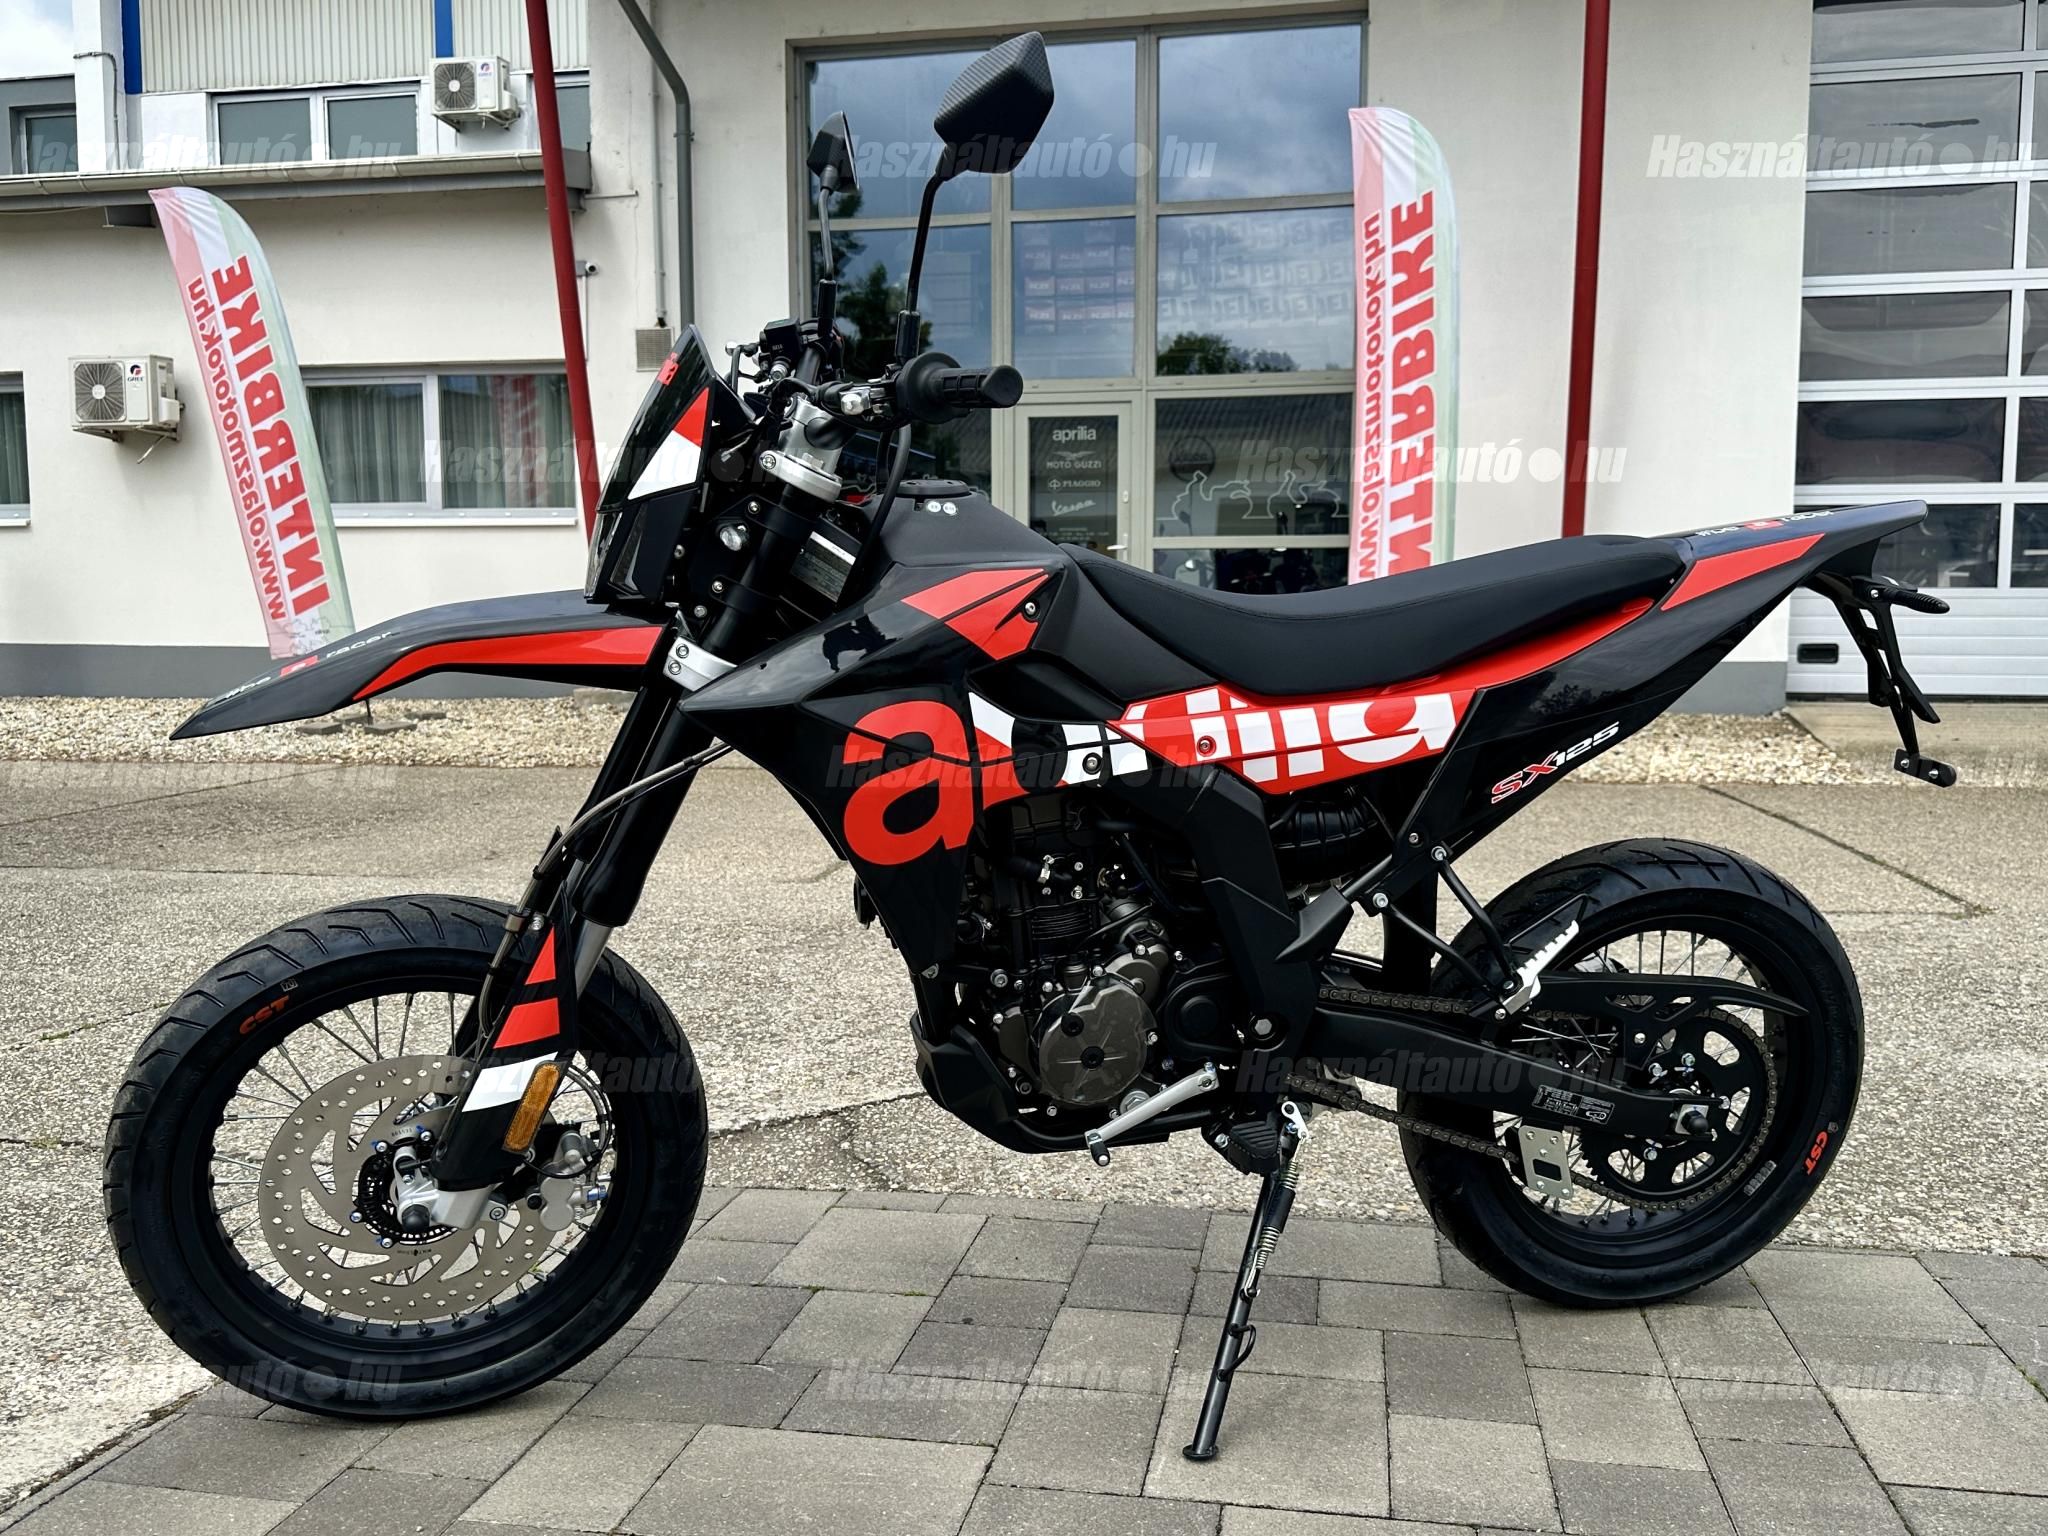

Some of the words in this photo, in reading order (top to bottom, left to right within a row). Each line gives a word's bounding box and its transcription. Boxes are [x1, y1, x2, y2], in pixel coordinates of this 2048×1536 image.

[1052, 425, 1097, 443] aprilia
[1046, 461, 1072, 469] MOTO
[1074, 461, 1102, 469] GUZZI
[326, 631, 392, 659] racer
[239, 994, 290, 1035] CST
[1804, 1130, 1829, 1176] CST
